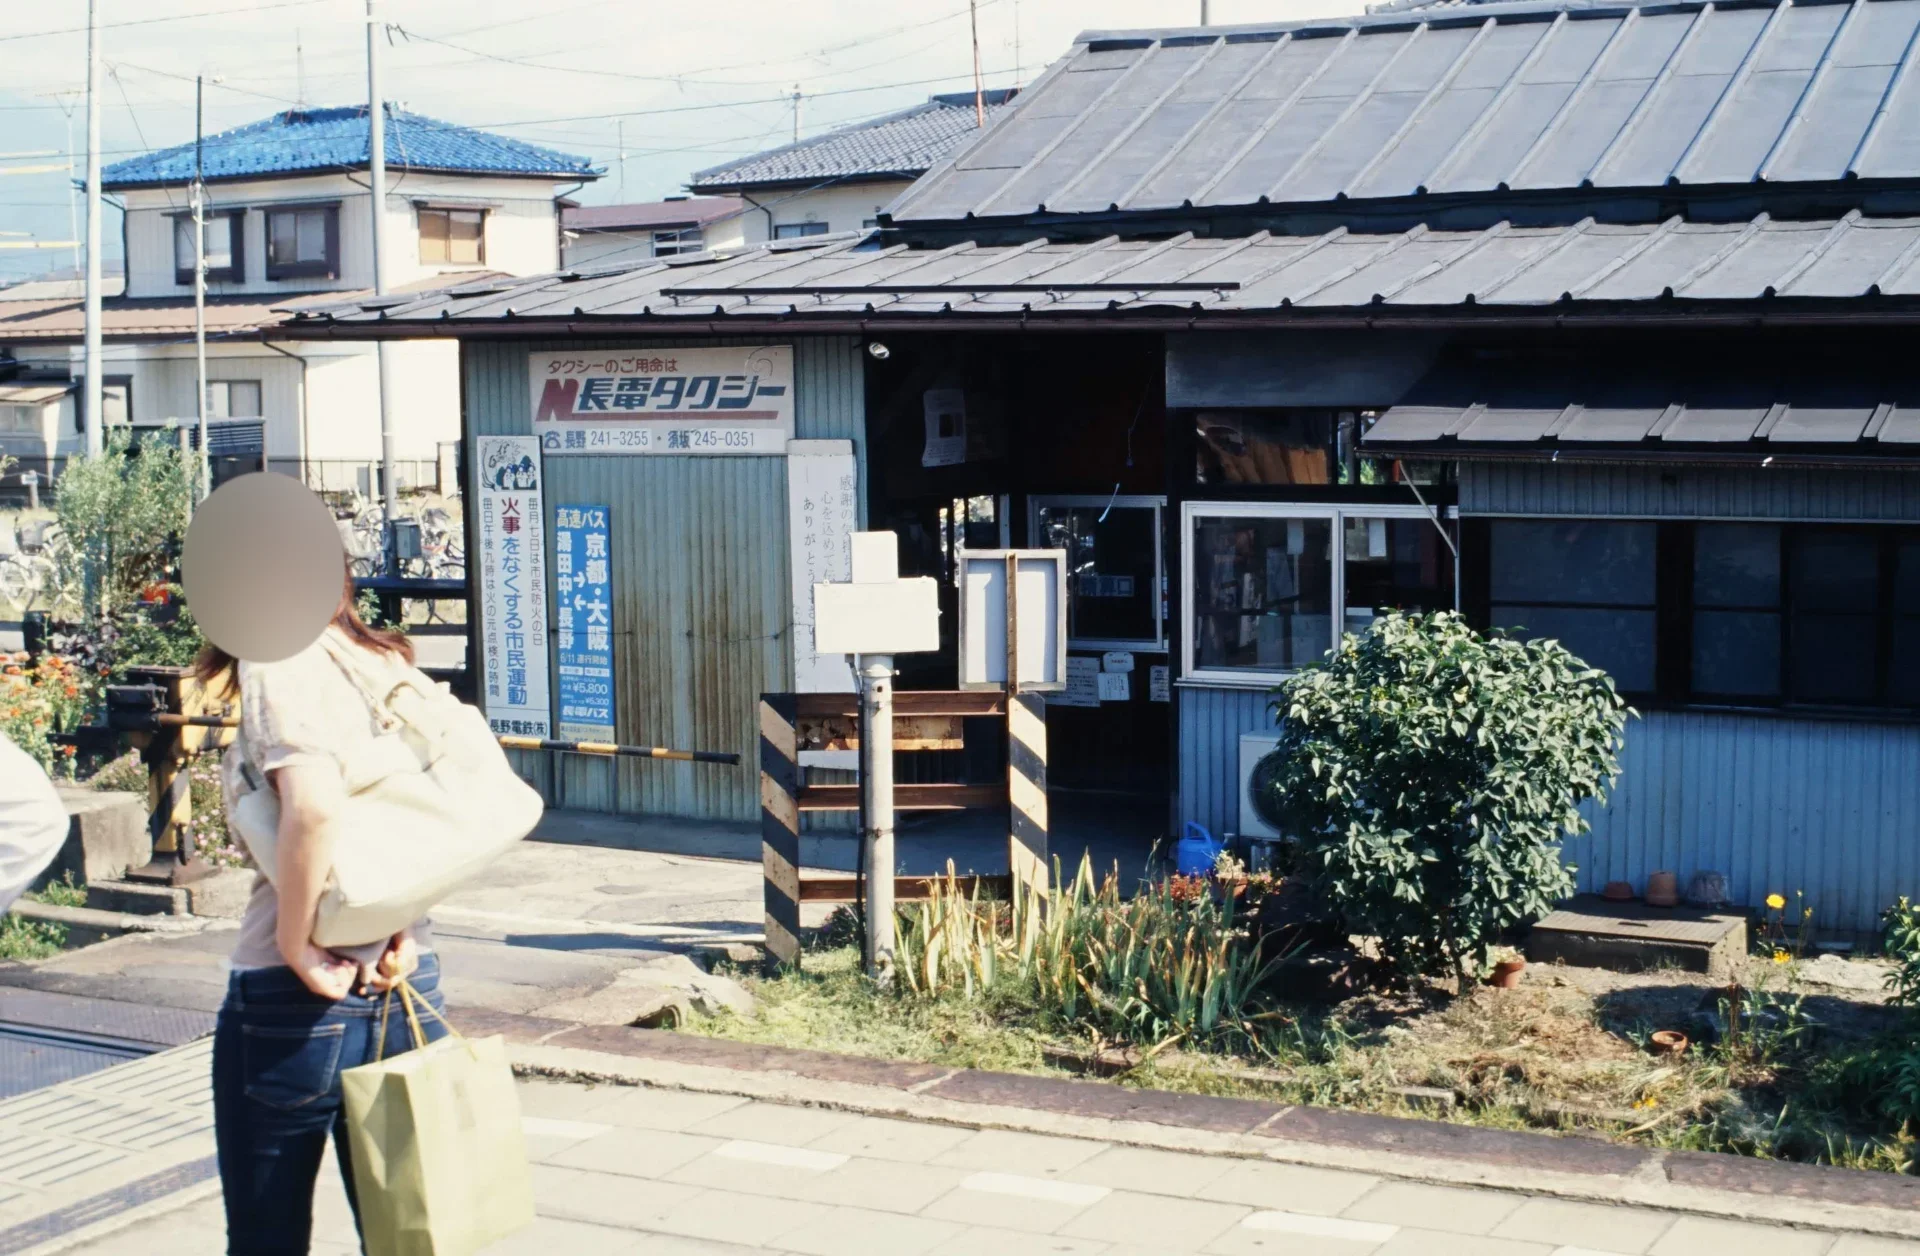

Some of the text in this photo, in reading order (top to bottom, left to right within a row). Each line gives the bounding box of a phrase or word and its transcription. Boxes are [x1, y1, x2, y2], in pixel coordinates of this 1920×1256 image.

[548, 357, 678, 374] タクシーのご用命は
[578, 374, 786, 411] 長電タクシー
[564, 429, 755, 449] 長野 241-3255 須坂 245-0351
[557, 508, 606, 529] 高速バス
[483, 497, 500, 697] 毎日午後九時は火の元点検の時間
[501, 496, 528, 705] 火事をなくする市民運動
[528, 497, 543, 646] 毎月七日は市民防火の日
[557, 531, 574, 650] 湯田中・長野
[585, 532, 609, 651] 京都・大阪
[562, 705, 609, 719] 長電バス
